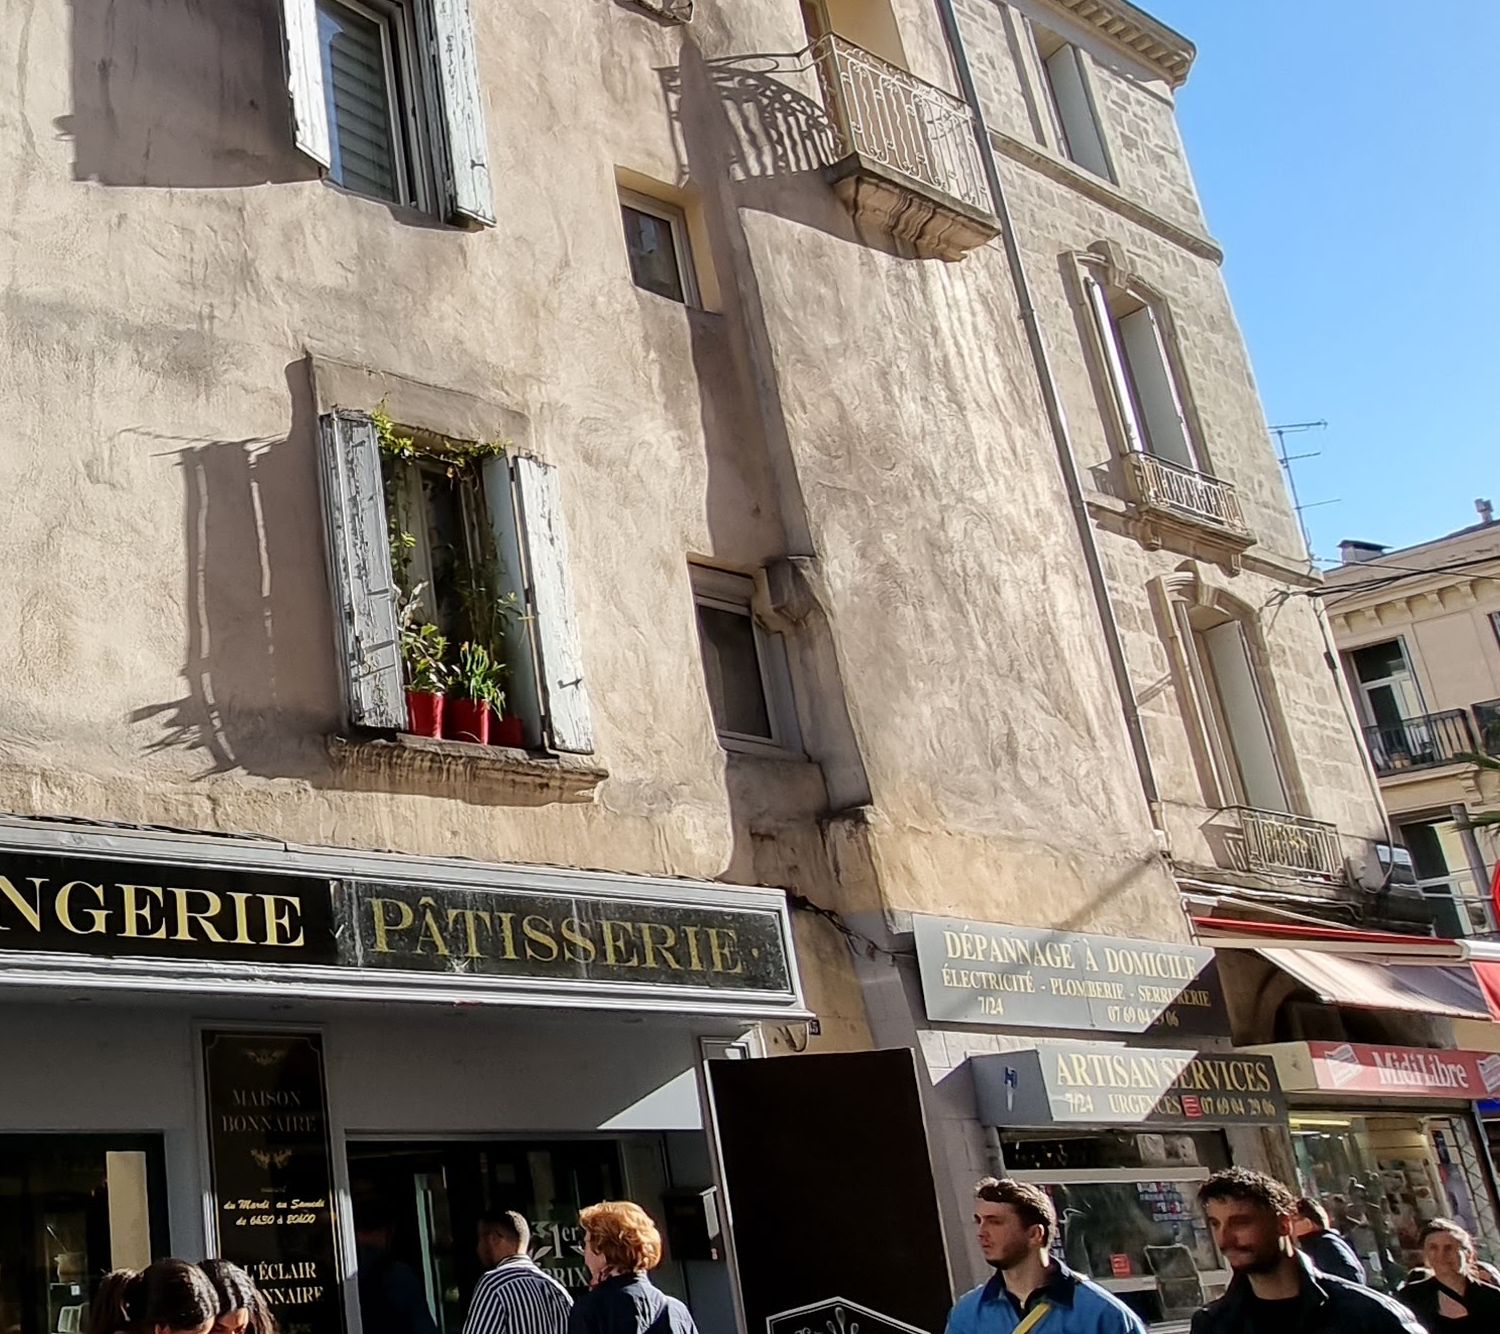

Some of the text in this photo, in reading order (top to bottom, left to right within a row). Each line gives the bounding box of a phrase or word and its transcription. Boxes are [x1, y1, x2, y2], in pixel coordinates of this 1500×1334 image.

[369, 896, 743, 974] PÂTISSERIE
[943, 925, 1199, 980] DÉPANNAGE À DOMICILE
[942, 964, 1035, 993] ÉLECTRICITÉ
[1051, 978, 1125, 1000] PLOMBERIE
[1139, 985, 1211, 1007] SERRURERIE
[978, 997, 1003, 1015] 7/24
[1108, 1005, 1120, 1022] 07
[1123, 1006, 1136, 1024] 69
[1056, 1053, 1271, 1092] ARTISAN SERVICES
[232, 1089, 301, 1107] MAISON
[1107, 1094, 1182, 1115] URGENCES
[222, 1115, 316, 1132] BONNAIRE
[261, 1286, 324, 1305] NNAIRE
